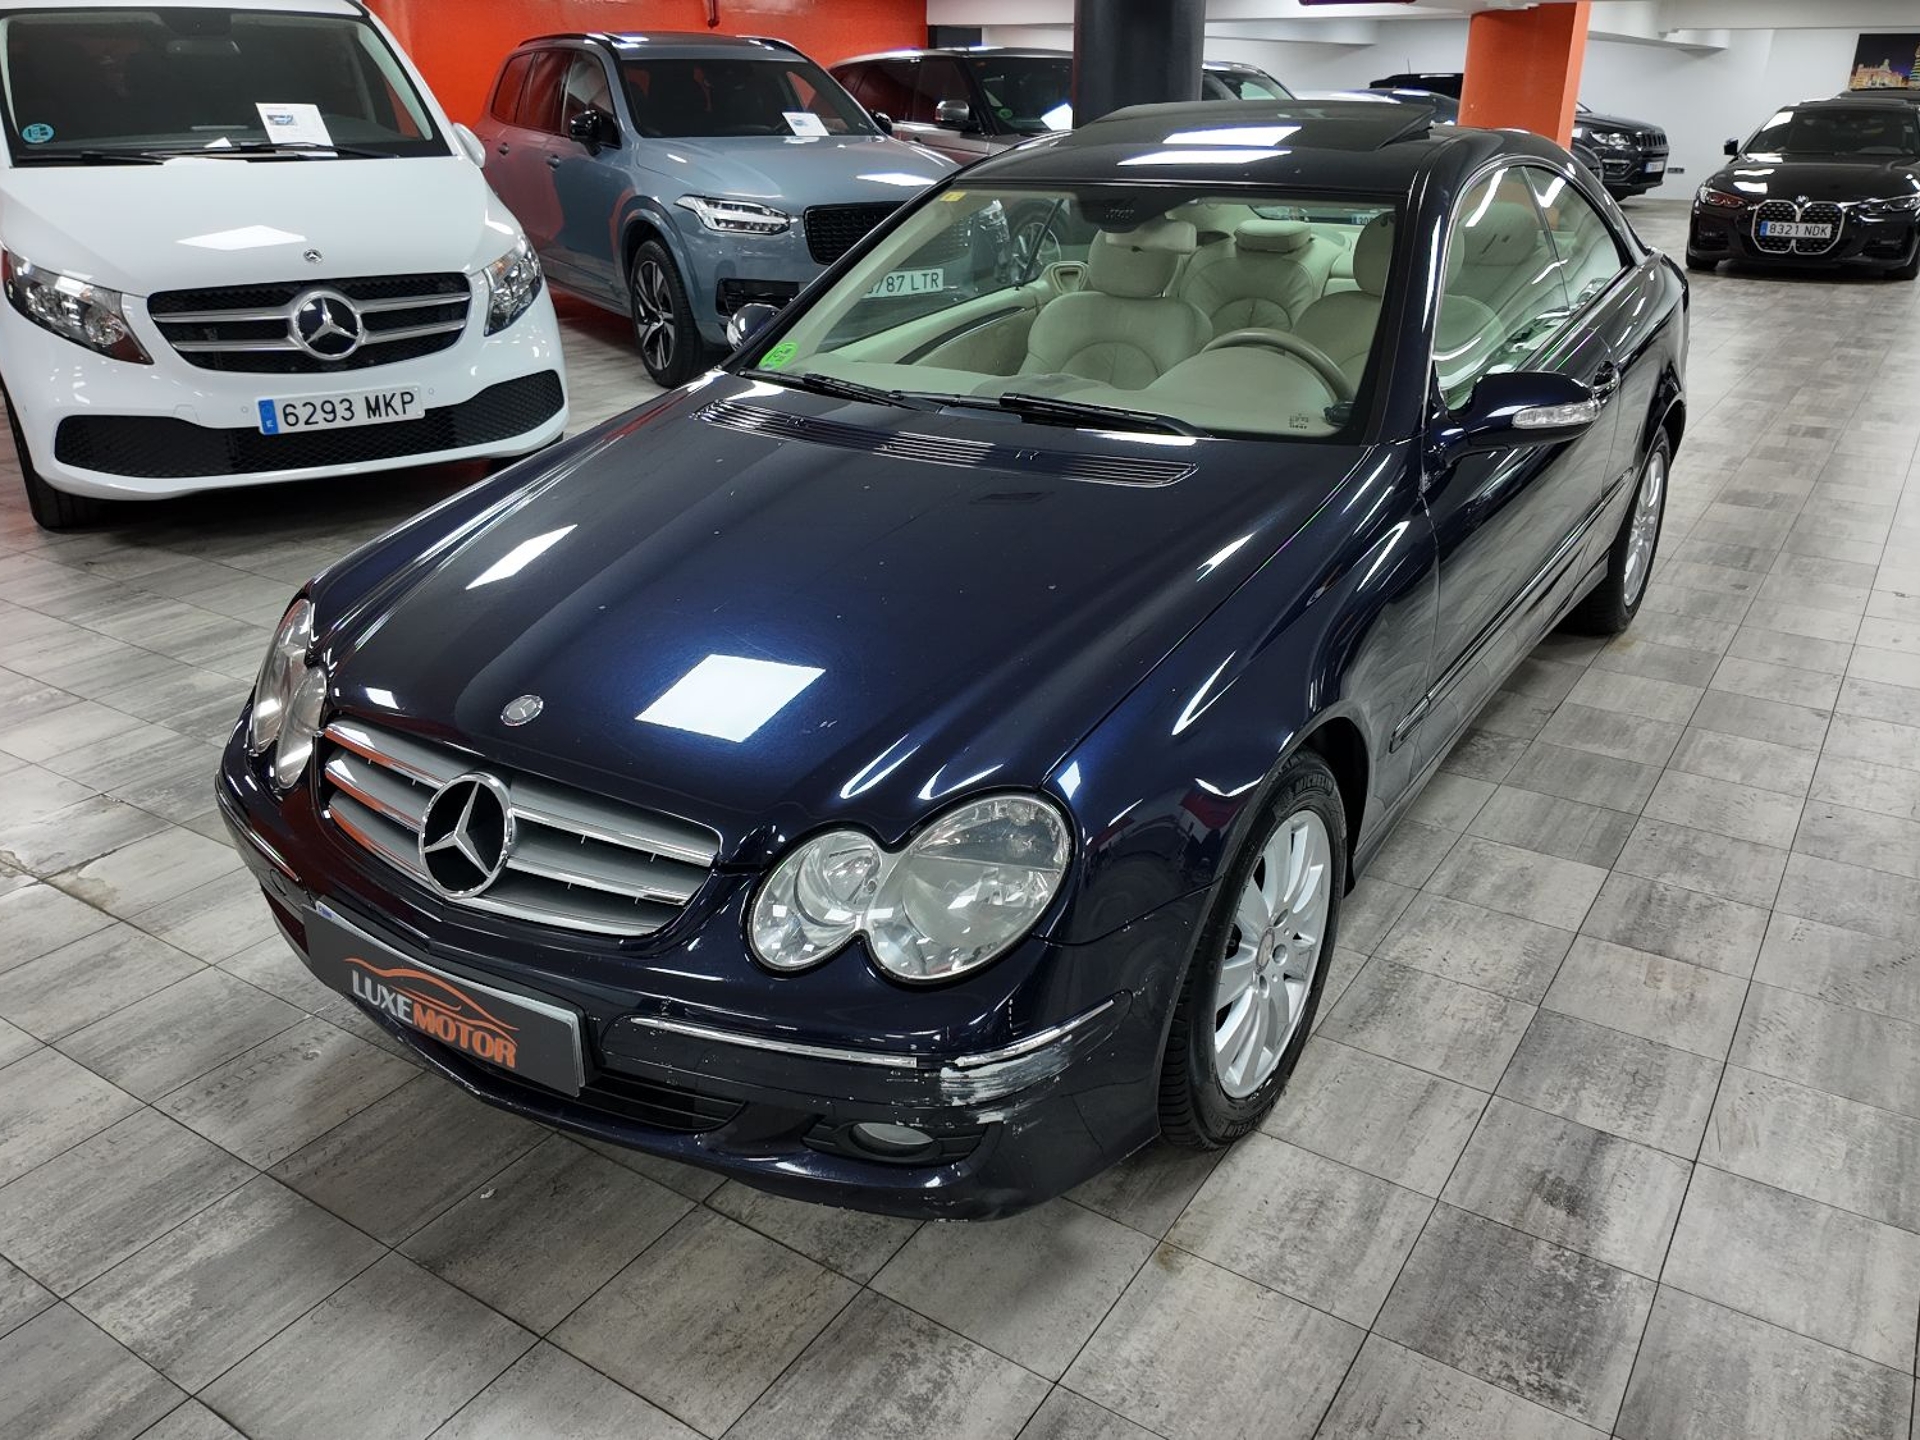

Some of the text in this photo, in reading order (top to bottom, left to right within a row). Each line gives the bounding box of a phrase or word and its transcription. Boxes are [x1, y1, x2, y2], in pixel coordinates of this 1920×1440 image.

[1769, 223, 1828, 236] 8321 NDK
[910, 272, 939, 291] LTR
[282, 391, 415, 427] 6293 MKP
[351, 969, 517, 1069] LUXEMOTOR
